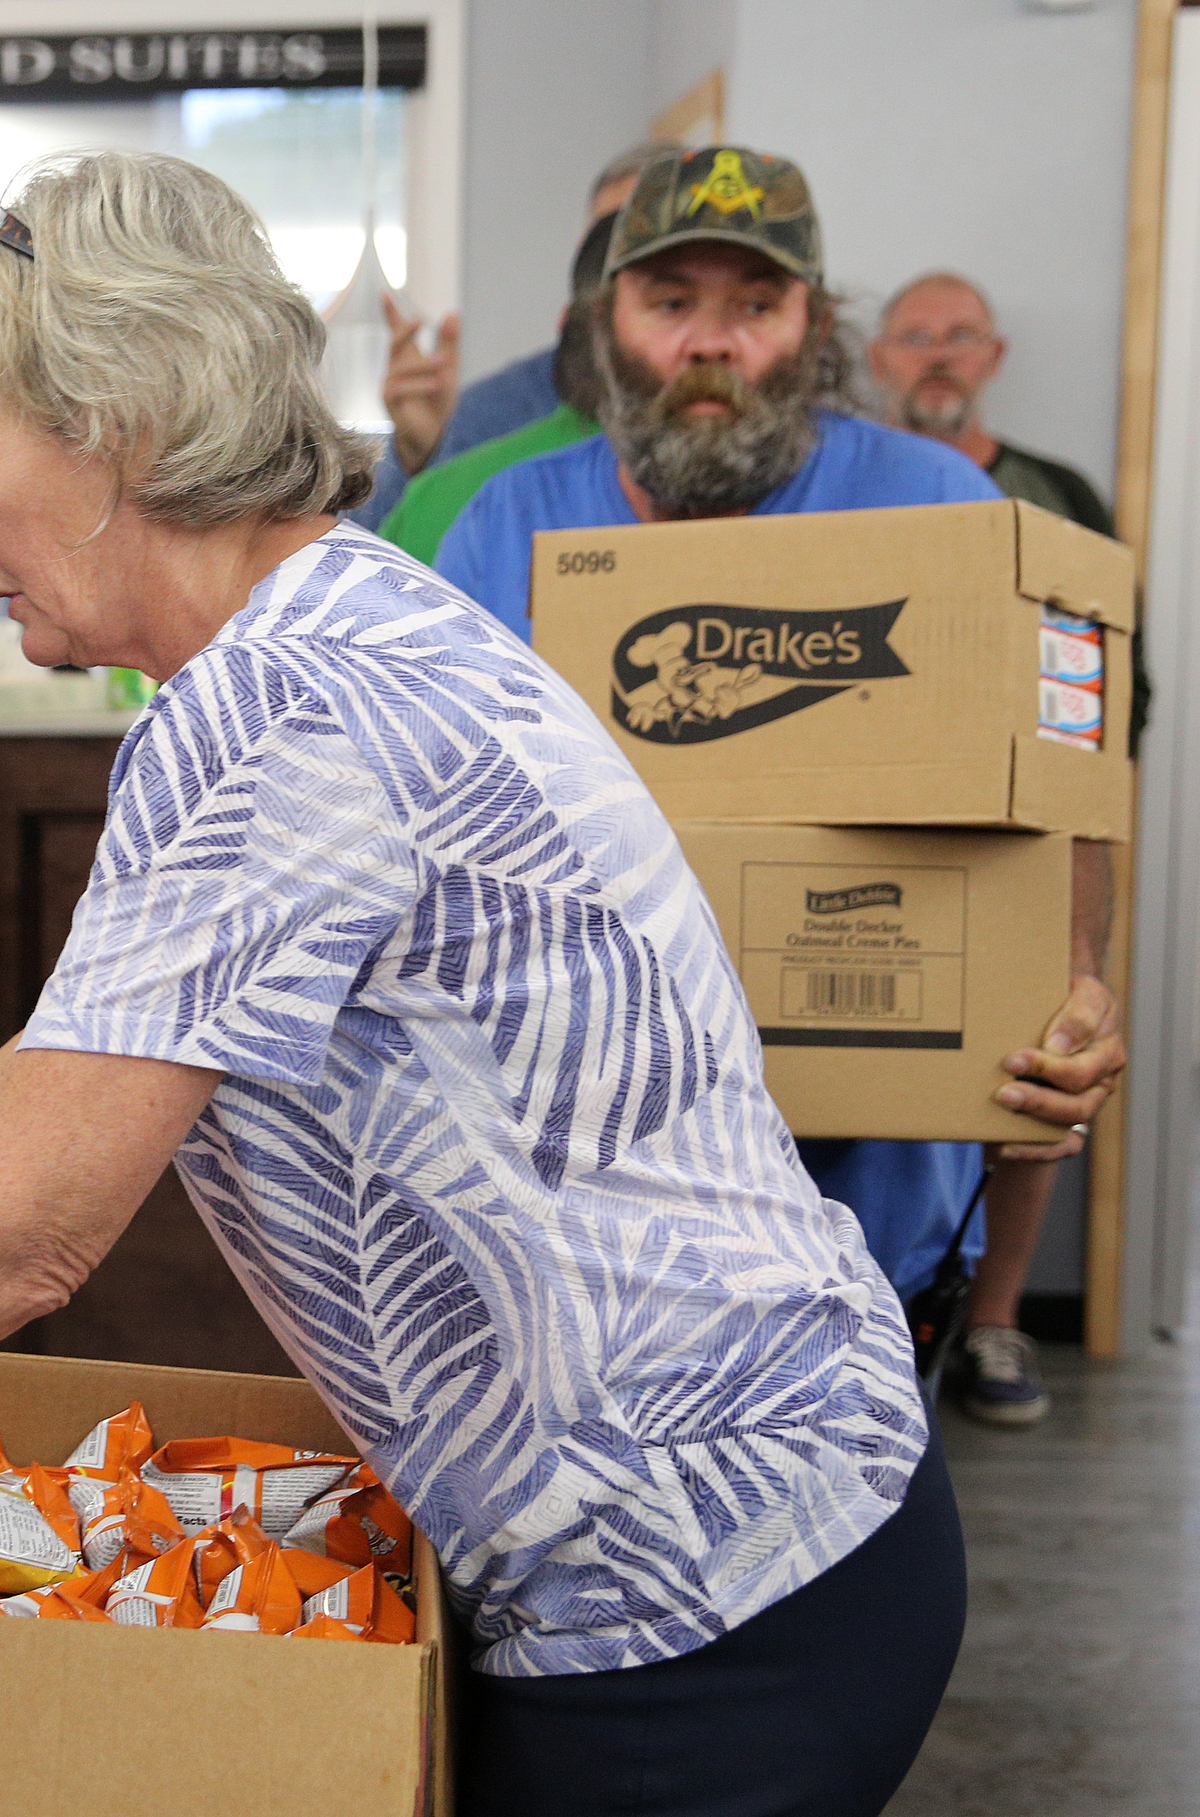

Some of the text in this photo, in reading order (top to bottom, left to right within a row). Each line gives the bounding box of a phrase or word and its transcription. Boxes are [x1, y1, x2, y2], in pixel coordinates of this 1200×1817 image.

[68, 33, 327, 83] SUITES
[557, 550, 617, 575] 5096
[696, 617, 862, 671] Drake's
[786, 933, 842, 948] Oatmeal
[894, 936, 920, 950] Pies
